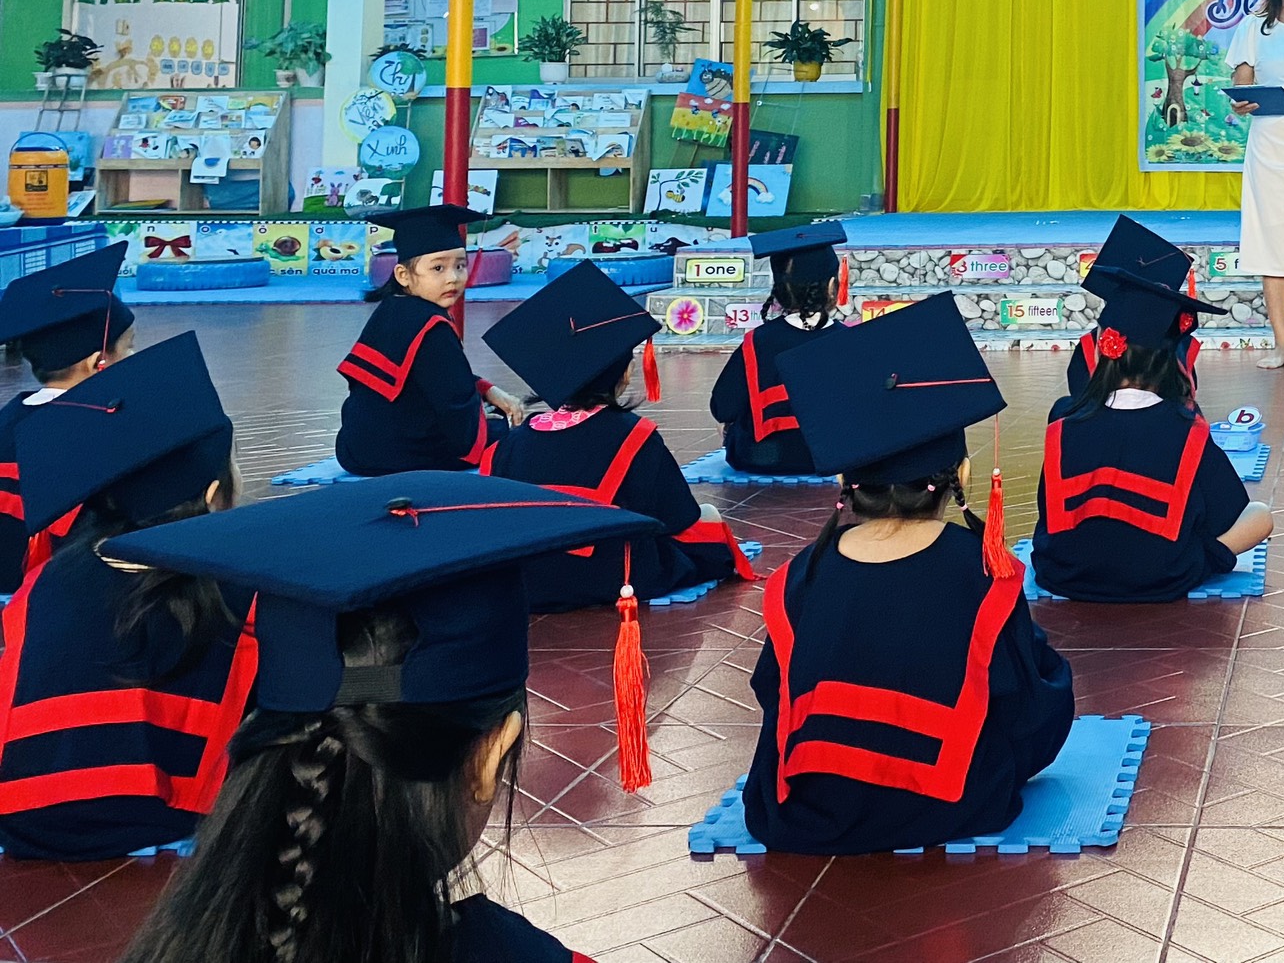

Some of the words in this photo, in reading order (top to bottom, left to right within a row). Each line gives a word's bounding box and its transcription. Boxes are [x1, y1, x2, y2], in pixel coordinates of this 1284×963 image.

[280, 267, 303, 275] sên
[694, 264, 700, 277] 1
[705, 265, 736, 275] one
[970, 260, 1007, 272] three
[1214, 258, 1227, 271] 5
[732, 309, 749, 322] 13
[1007, 305, 1025, 318] 15
[1028, 304, 1058, 316] fifteen
[1235, 410, 1254, 424] b
